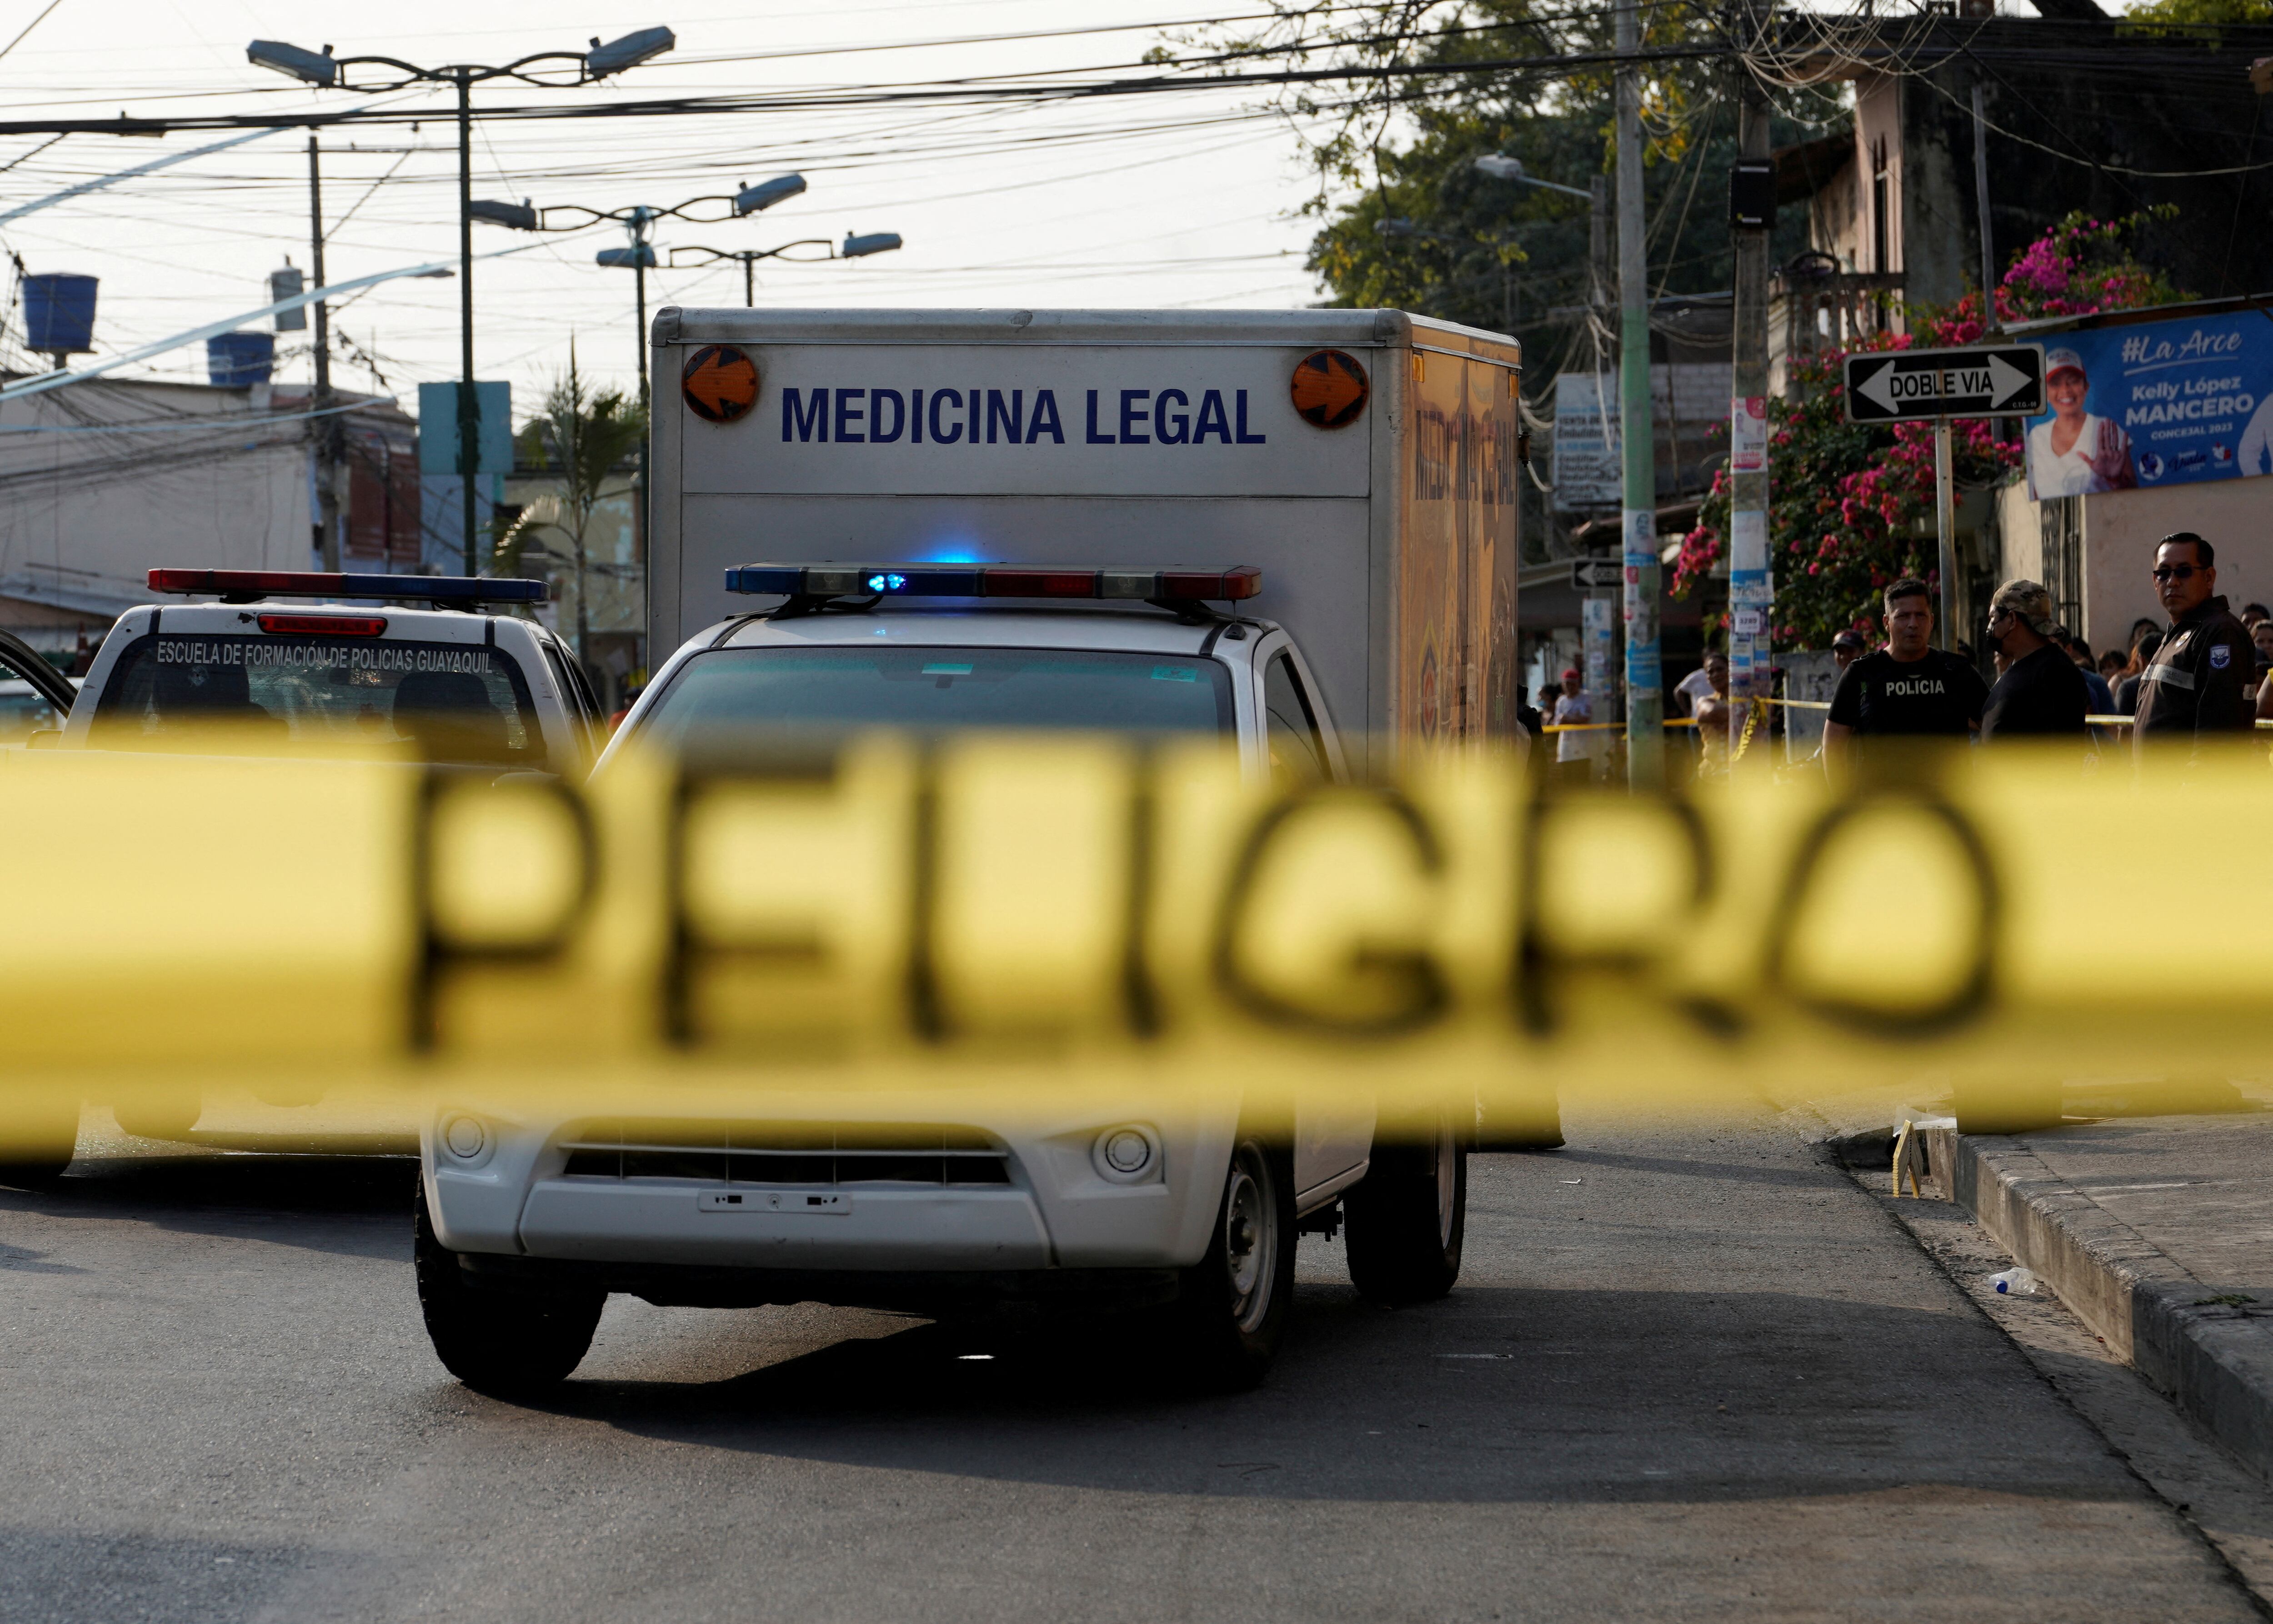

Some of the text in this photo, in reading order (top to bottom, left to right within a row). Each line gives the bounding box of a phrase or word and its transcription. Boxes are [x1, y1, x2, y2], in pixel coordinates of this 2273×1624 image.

[2122, 329, 2243, 363] #La Arce
[1890, 371, 1994, 398] DOBLE VIA
[2132, 376, 2242, 402] Kelly López
[781, 387, 1267, 445] MEDICINA LEGAL
[2125, 392, 2254, 427] MANCERO
[2151, 422, 2233, 441] CONCEJAL 2023
[157, 641, 493, 674] ESCUELA DE FORMACIÓN DE POLICIAS GUAYAQUIL
[1886, 679, 1945, 697] POLICIA
